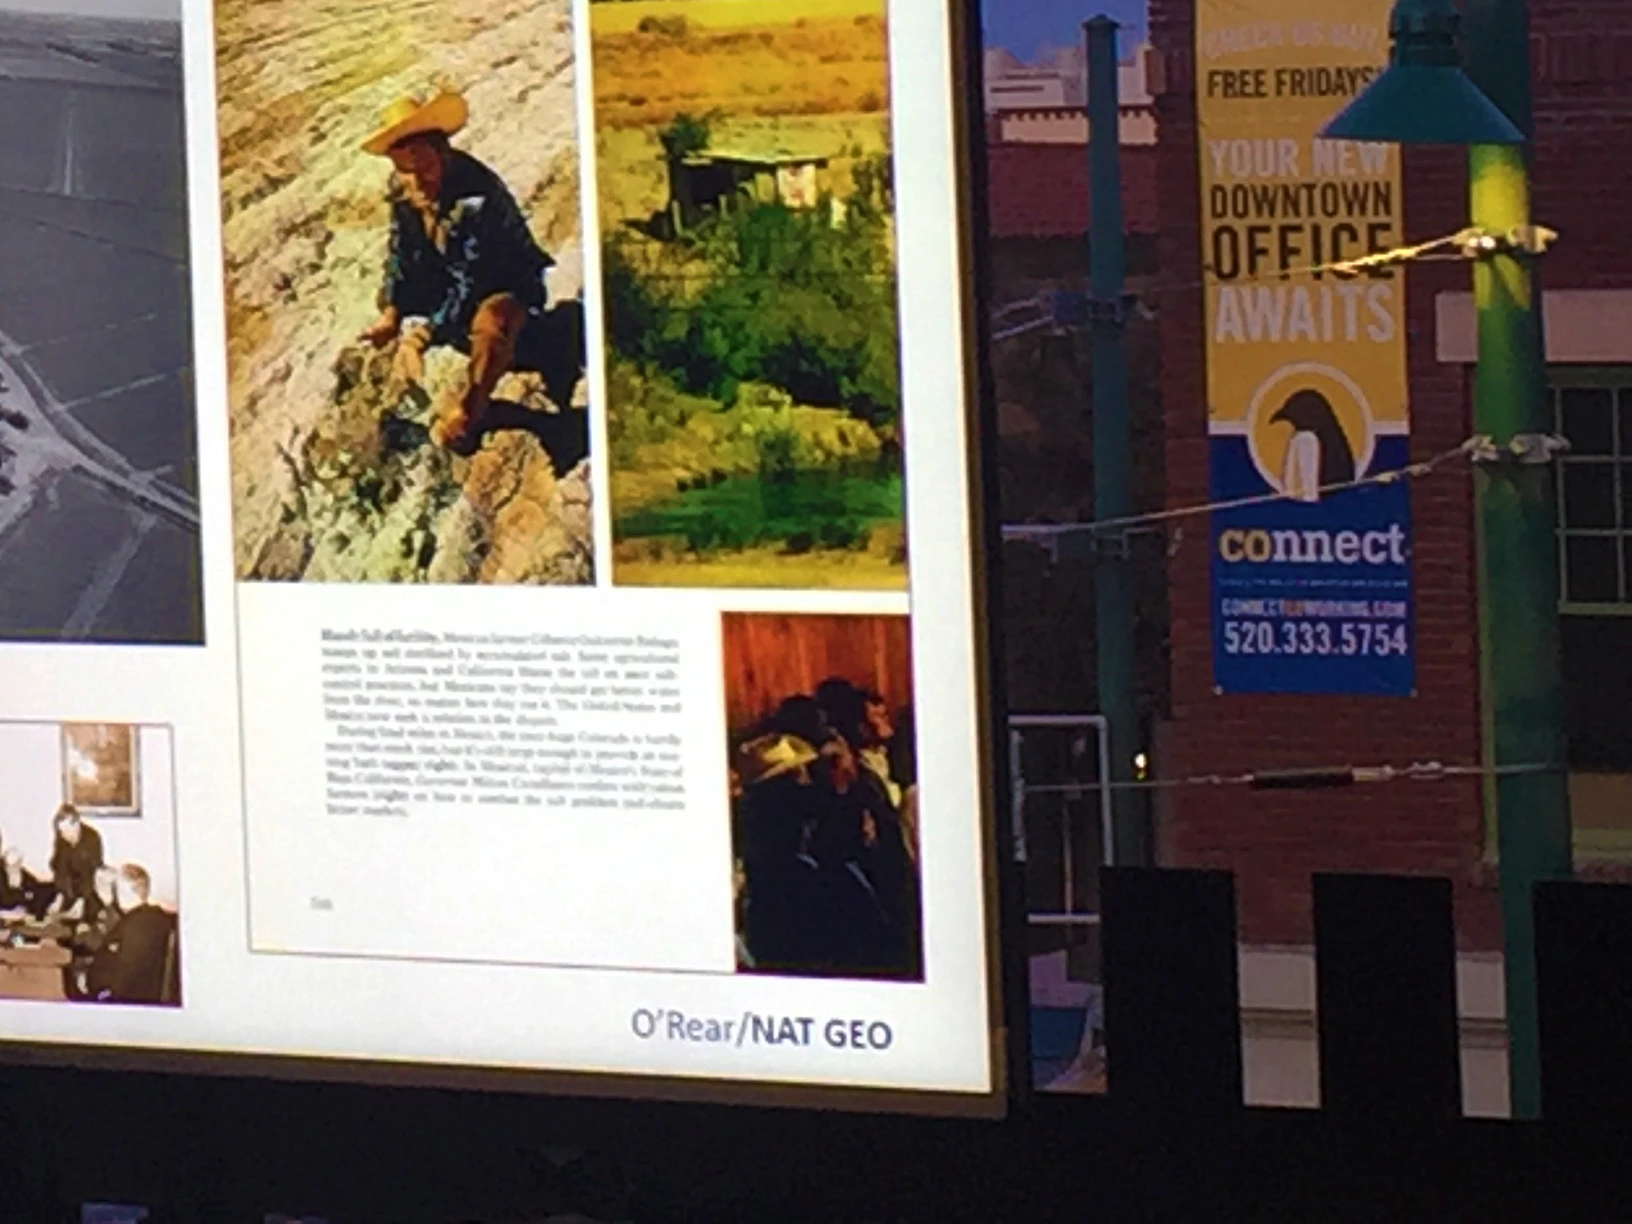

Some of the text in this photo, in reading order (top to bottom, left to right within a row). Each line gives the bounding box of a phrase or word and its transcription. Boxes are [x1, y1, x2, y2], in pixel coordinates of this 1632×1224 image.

[1207, 68, 1268, 98] FREE
[1208, 139, 1389, 178] YOUR NEW
[1210, 181, 1392, 219] DOWNTOWN
[1212, 222, 1395, 281] OFFICE
[1216, 283, 1395, 344] AWAITS
[1220, 524, 1406, 564] connect
[1224, 622, 1408, 656] 520.333.5754
[630, 1007, 894, 1050] O'Rear/NAT GEO
